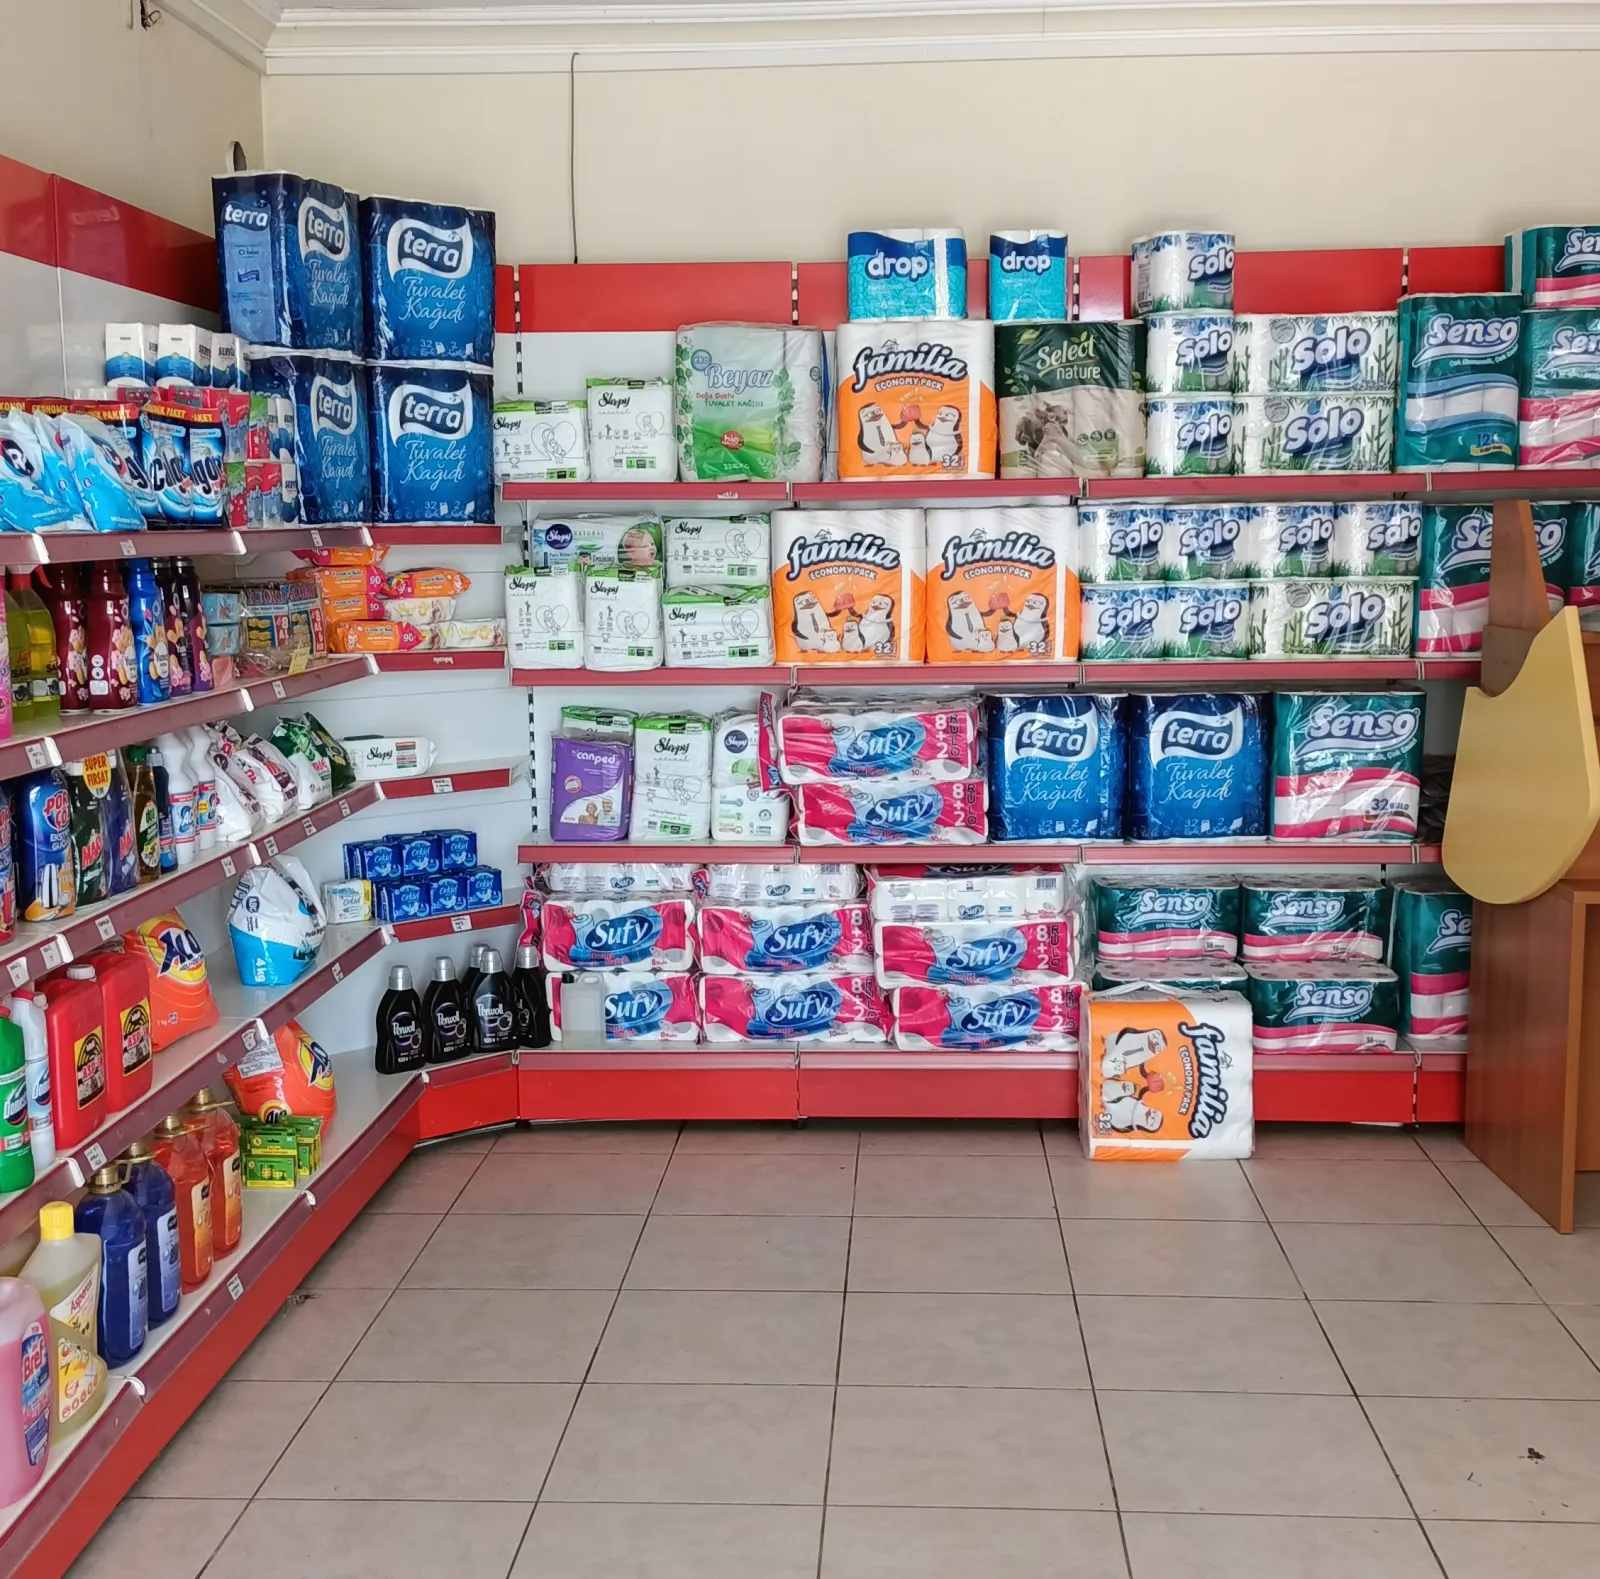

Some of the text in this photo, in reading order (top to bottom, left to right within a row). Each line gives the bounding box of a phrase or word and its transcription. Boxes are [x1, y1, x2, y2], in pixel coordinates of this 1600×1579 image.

[225, 203, 268, 227] terra
[305, 207, 344, 250] terra
[403, 230, 460, 268] terra
[1003, 250, 1051, 274] drop
[867, 248, 928, 280] drop
[1187, 247, 1234, 281] Solo
[403, 276, 466, 300] Tuvalet
[398, 297, 466, 329] Kağıdı
[1428, 314, 1520, 346] Senso
[1036, 336, 1096, 370] Select
[1176, 330, 1232, 367] Solo
[1291, 326, 1371, 374] Solo
[705, 363, 774, 395] Beyaz
[852, 343, 967, 394] familia
[1056, 364, 1101, 380] nature
[696, 392, 713, 400] Doğa
[874, 377, 945, 393] ECONOMY PACK
[319, 384, 352, 422] terra
[405, 391, 461, 428] terra
[598, 392, 631, 408] Sleepy
[493, 417, 522, 431] Sleepy
[1177, 413, 1232, 450] Solo
[1283, 406, 1365, 454] Solo
[406, 436, 467, 461] Tuvalet
[1476, 433, 1492, 447] 12
[399, 457, 467, 490] Kağıdı
[942, 454, 959, 469] 32
[547, 530, 572, 543] Sleepy
[675, 521, 702, 536] Sleepy
[1109, 520, 1164, 556] Solo
[1179, 518, 1242, 556] Solo
[1278, 516, 1335, 553] Solo
[1366, 515, 1423, 552] Solo
[786, 533, 901, 582] familia
[941, 531, 1055, 582] familia
[370, 576, 381, 585] 90
[508, 576, 537, 591] Sleepy
[808, 565, 878, 581] ECONOMY PACK
[964, 565, 1033, 581] ECONOMY PACK
[590, 580, 620, 596] Sleepy
[668, 607, 697, 622] Sleepy
[1097, 598, 1160, 636] Solo
[1179, 598, 1243, 634] Solo
[1303, 592, 1386, 639] Solo
[403, 632, 415, 643] 90
[874, 641, 893, 655] 32
[1028, 641, 1046, 655] 32
[1021, 718, 1084, 751] terra
[1168, 720, 1230, 750] terra
[1308, 704, 1418, 739] Senso
[366, 746, 394, 761] Sleepy
[653, 737, 690, 756] Sleepy
[725, 735, 748, 747] Sleepy
[850, 729, 911, 760] Sufy
[576, 750, 617, 765] canped
[1165, 761, 1236, 781] Tuvalet
[1019, 763, 1090, 782] Tuvalet
[1013, 780, 1087, 810] Kağıdı
[1158, 779, 1232, 810] Kağıdı
[1371, 798, 1390, 812] 32
[871, 797, 932, 826] Sufy
[1138, 889, 1213, 914] Senso
[1271, 893, 1345, 918] Senso
[591, 918, 649, 949] Sufy
[769, 924, 828, 953] Sufy
[951, 940, 1013, 969] Sufy
[604, 992, 659, 1020] Sufy
[770, 992, 830, 1023] Sufy
[1295, 982, 1375, 1006] Senso
[436, 1010, 461, 1027] Perwoll
[476, 1002, 504, 1018] Perwoll
[966, 1001, 1028, 1028] Sufy
[391, 1020, 417, 1036] Perwoll
[1177, 1021, 1229, 1139] familia
[1177, 1044, 1195, 1116] ECONOMY PACK
[1099, 1112, 1112, 1136] 32
[22, 1340, 44, 1382] Bref
